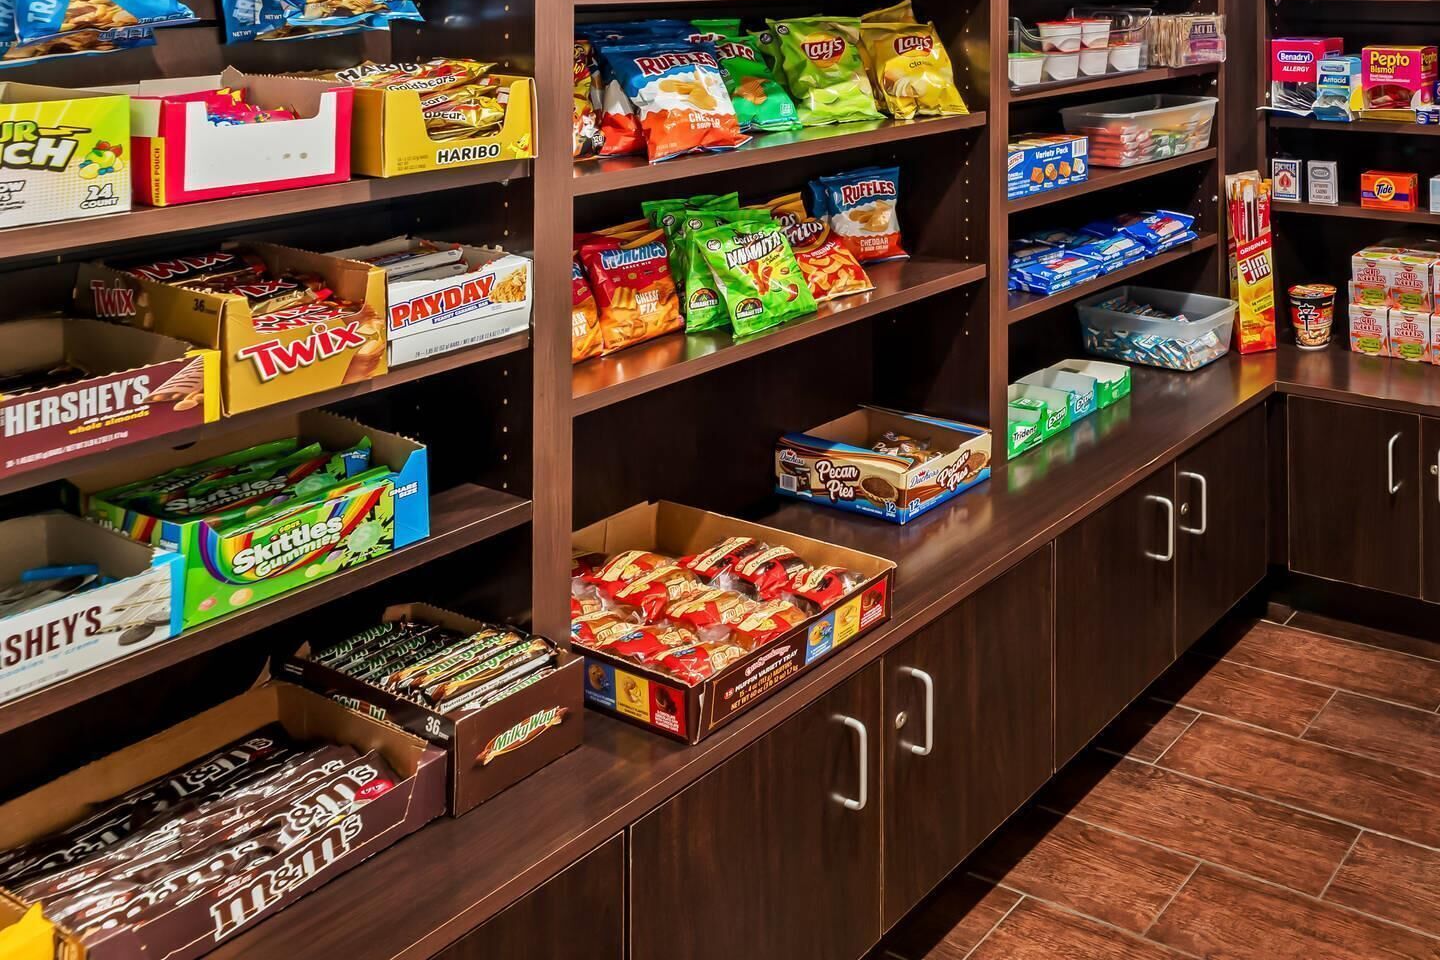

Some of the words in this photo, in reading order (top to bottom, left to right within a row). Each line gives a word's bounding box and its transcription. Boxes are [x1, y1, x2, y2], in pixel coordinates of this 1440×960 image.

[805, 38, 843, 61] Lay's
[899, 34, 932, 54] Lay's
[634, 51, 718, 77] RUFFLES
[1280, 52, 1311, 64] Benadryl
[1370, 51, 1410, 67] Pepto
[1282, 65, 1310, 73] ALLERGY
[1370, 65, 1395, 74] Bismol
[1322, 76, 1347, 84] Antacid
[437, 144, 500, 164] HARIBO
[1035, 149, 1054, 159] Variety
[1055, 146, 1069, 156] Pack
[153, 147, 161, 176] POUCH
[87, 184, 114, 201] 24
[841, 180, 896, 205] RUFFLES
[1375, 183, 1394, 195] Tide
[80, 197, 119, 210] COUNT
[733, 232, 764, 245] Doritos
[860, 238, 890, 247] CHEDDAR
[1239, 238, 1269, 254] ORIGINAL
[600, 241, 668, 270] MUNCHIES
[1356, 274, 1386, 284] NOODLES
[1365, 268, 1380, 277] CUP
[193, 298, 206, 312] 36
[390, 274, 495, 329] PAYDAY
[635, 289, 660, 305] CHEESE
[639, 302, 658, 316] FIX
[1394, 328, 1424, 339] NOODLES
[1404, 323, 1419, 331] CUP
[3, 374, 150, 438] HERSHEY'S
[1012, 424, 1037, 442] Trident
[779, 448, 805, 466] Duchess
[815, 460, 859, 482] Pecan
[937, 450, 972, 488] Pecan
[909, 468, 940, 489] Duchess
[947, 465, 970, 491] Pies
[828, 478, 855, 501] Pies
[885, 500, 896, 513] 12
[908, 498, 921, 512] 12
[231, 515, 345, 576] Skittles
[255, 531, 342, 578] Gummies
[758, 658, 783, 678] VARIETY
[783, 648, 799, 663] TRAY
[424, 715, 441, 736] 36
